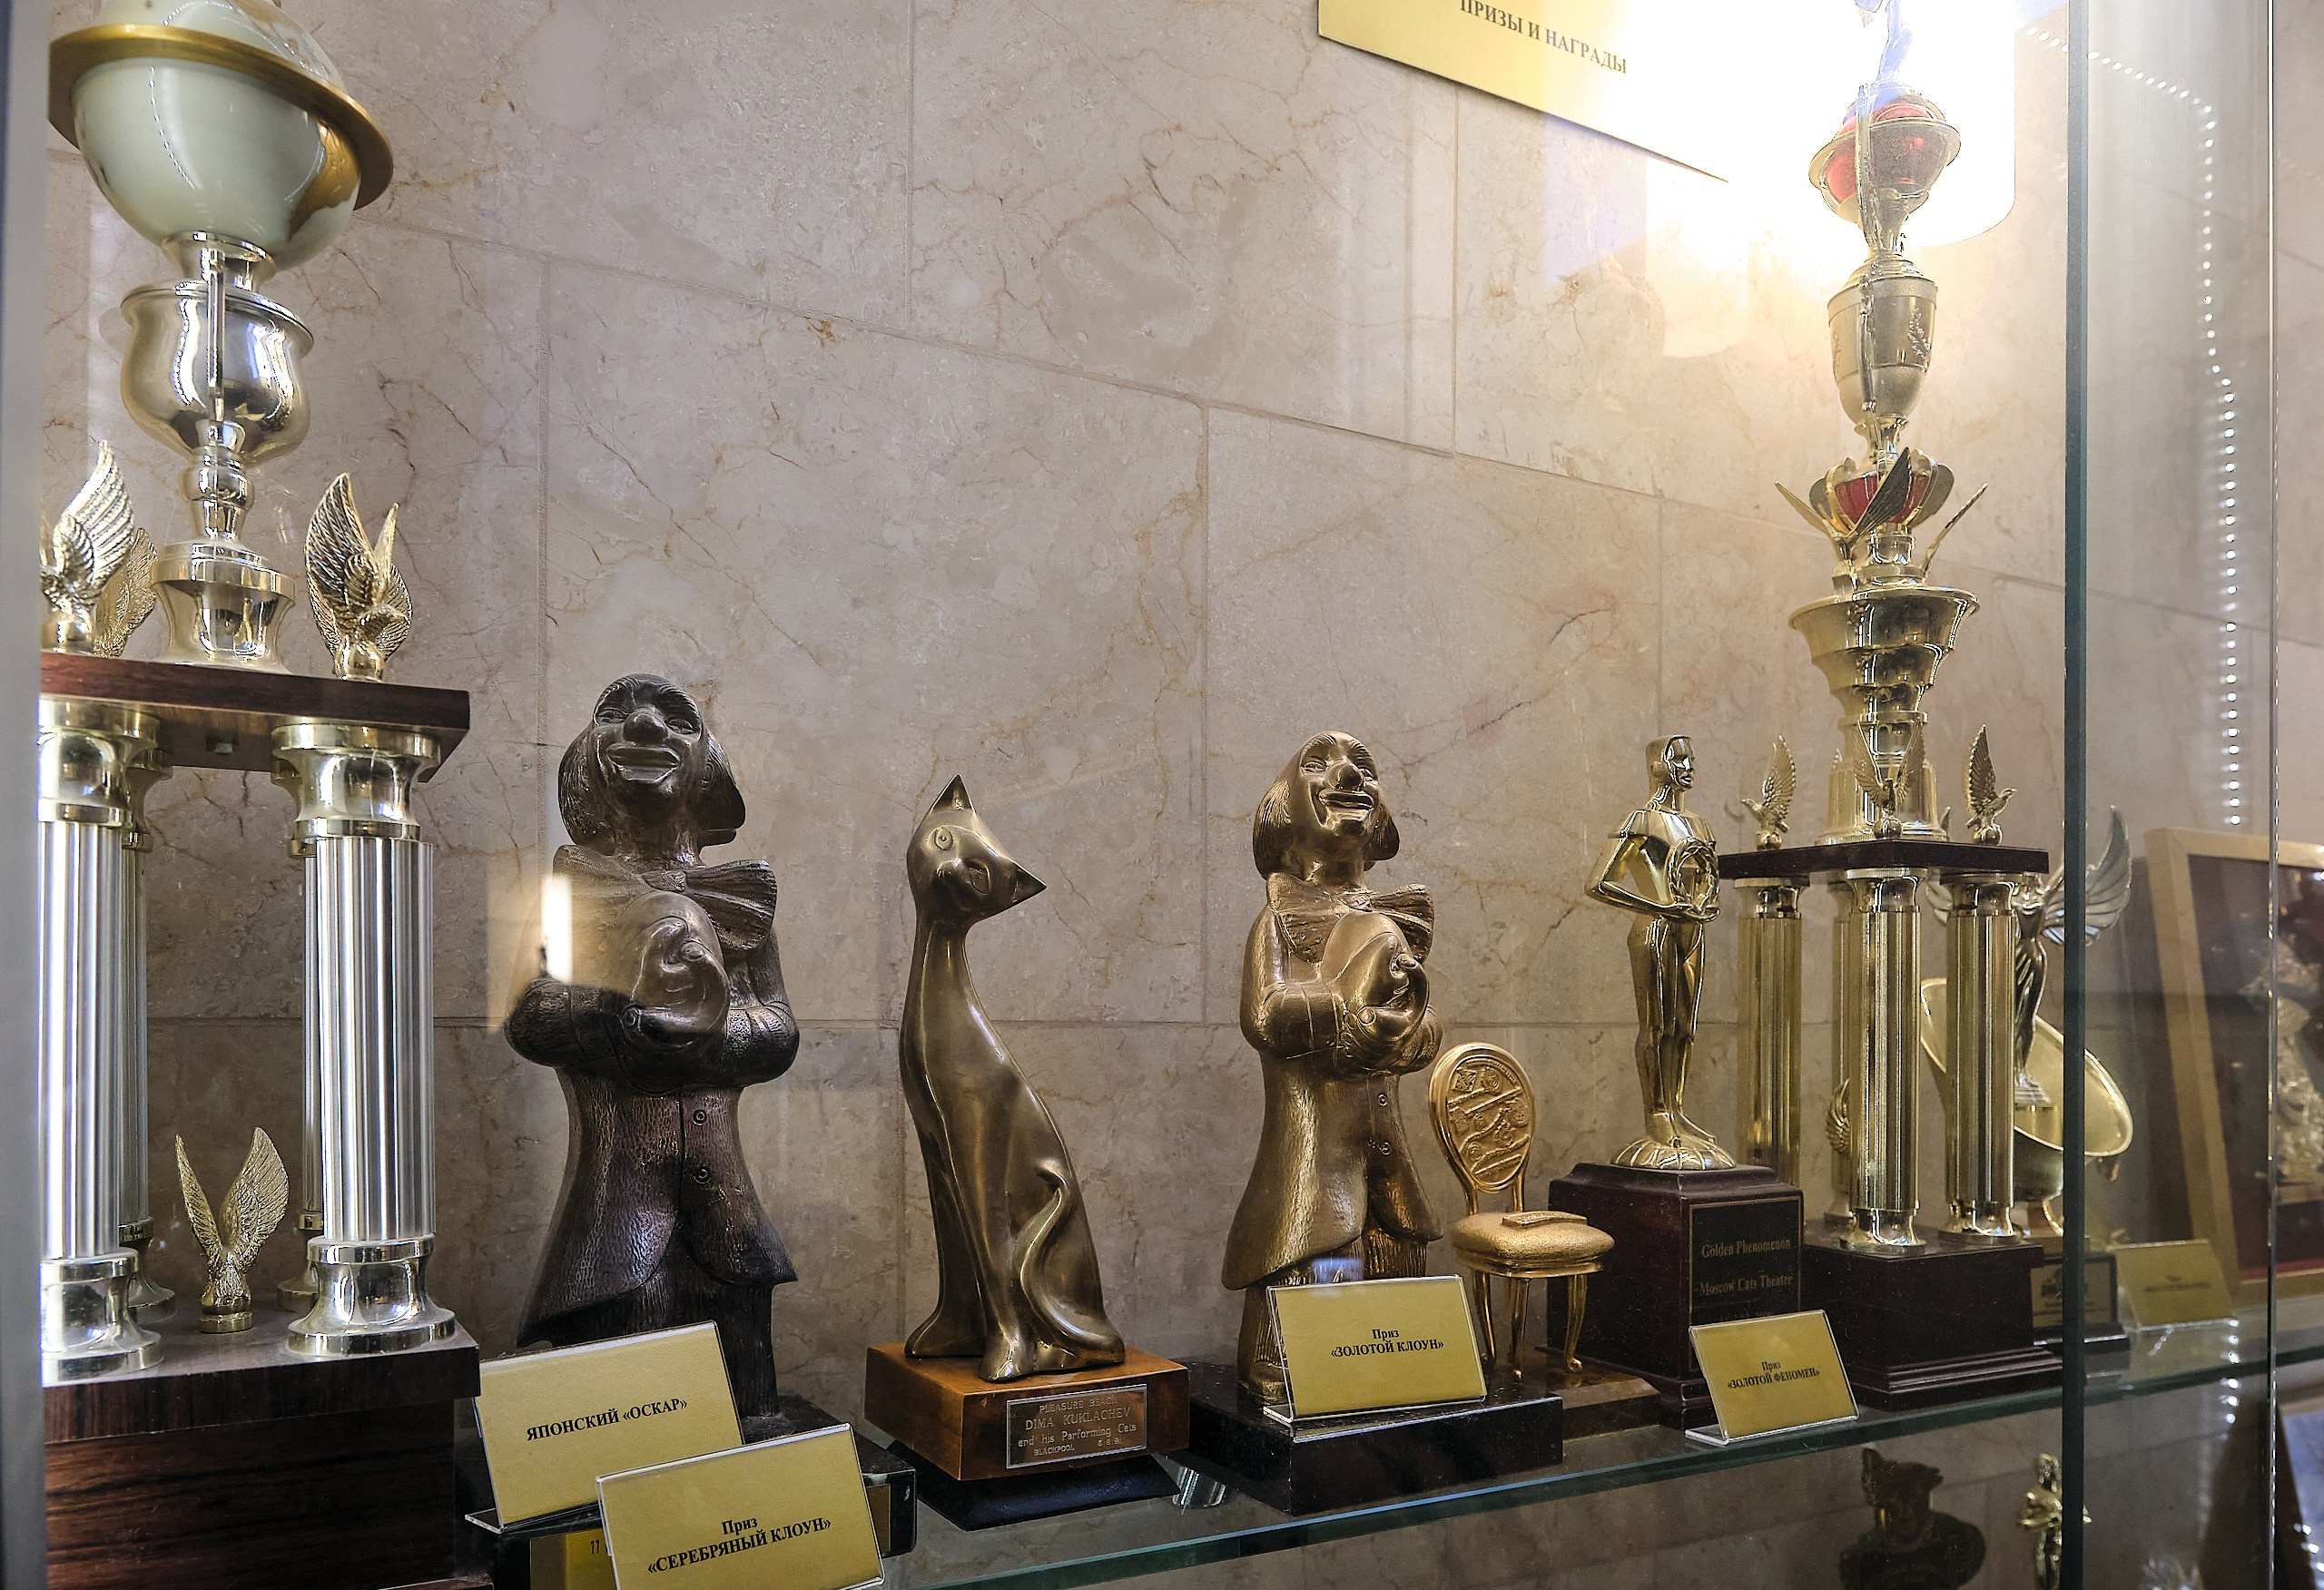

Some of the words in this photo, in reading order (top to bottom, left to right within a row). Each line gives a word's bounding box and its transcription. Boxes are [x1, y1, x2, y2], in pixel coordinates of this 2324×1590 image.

[1460, 0, 1522, 34] ПРИЗЫ
[1528, 21, 1541, 41] И
[1545, 28, 1628, 74] НАГРАДЫ
[1701, 1242, 1734, 1259] Golden
[1736, 1239, 1791, 1254] Phenomenon
[1699, 1280, 1735, 1296] Moscow
[1738, 1278, 1758, 1291] Cats
[1760, 1272, 1793, 1289] Theatre
[1372, 1329, 1400, 1340] Приз
[1331, 1340, 1395, 1358] «ЗОЛОТОЙ
[1397, 1339, 1444, 1352] КЛОУН»
[1761, 1361, 1781, 1372] Приз
[1728, 1372, 1773, 1389] «ЗОЛОТОЙ
[1774, 1368, 1820, 1382] ФЕНОМЕН»
[1039, 1400, 1084, 1413] PLEASURE
[1089, 1396, 1118, 1408] BEACH
[527, 1408, 620, 1441] ЯПОНСКИЙ
[623, 1398, 688, 1420] «ОСКАР»
[1025, 1418, 1054, 1430] DIMA
[1063, 1406, 1131, 1426] KUKLACHEV
[1019, 1435, 1035, 1447] and
[1041, 1433, 1055, 1444] his
[1061, 1426, 1111, 1441] Performing
[1118, 1423, 1137, 1434] Cats
[1033, 1444, 1075, 1457] BLACKPOOL
[721, 1517, 758, 1536] Приз
[647, 1529, 768, 1574] «СЕРЕБРЯНЫЙ
[771, 1517, 832, 1542] КЛОУН»
